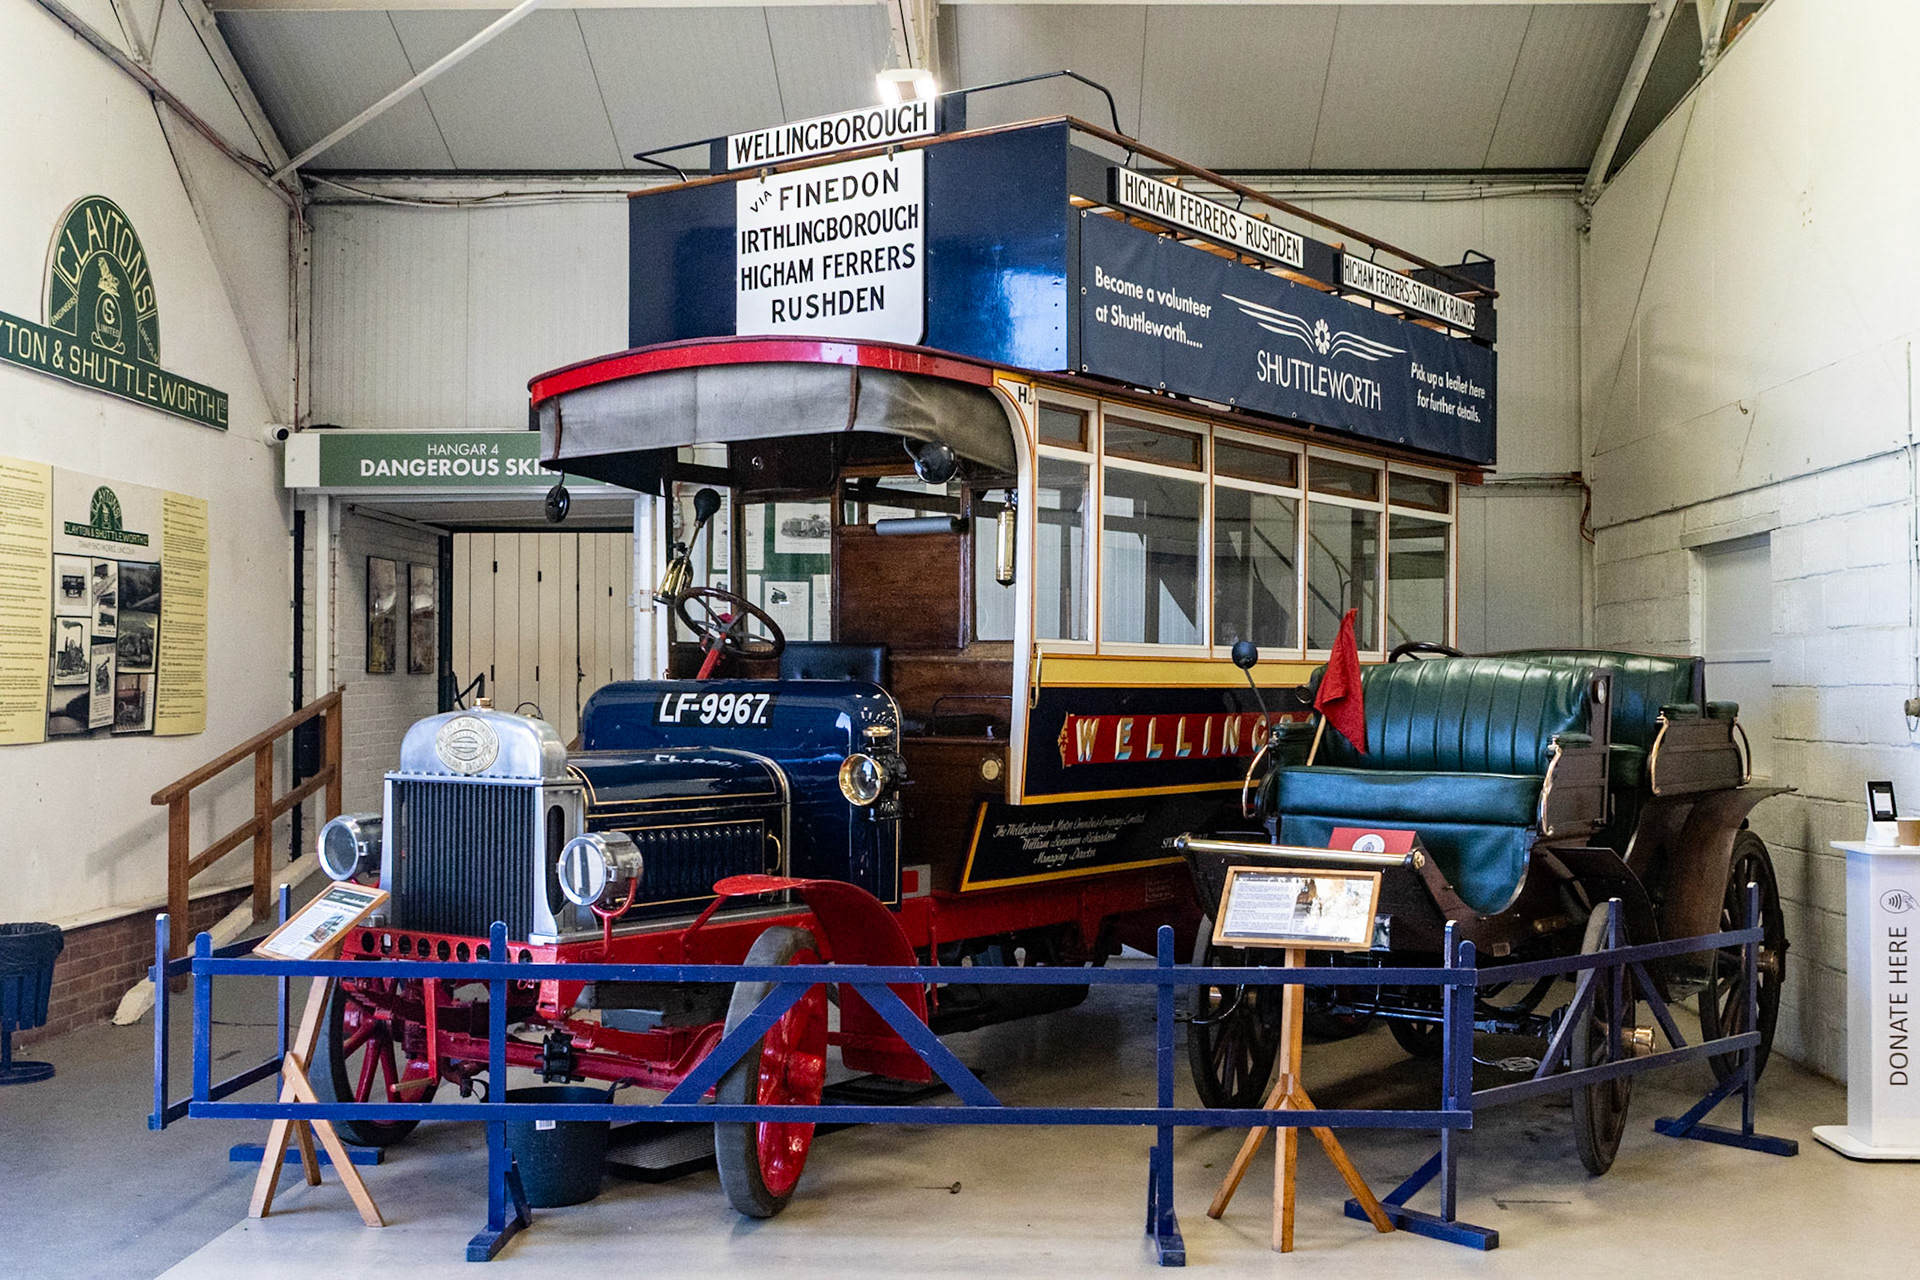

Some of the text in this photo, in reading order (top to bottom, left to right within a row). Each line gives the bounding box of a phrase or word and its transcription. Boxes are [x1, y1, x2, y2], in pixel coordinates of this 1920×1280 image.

[735, 102, 928, 164] WELLINGBOROUGH
[750, 167, 899, 213] VIA FINEDON
[741, 204, 919, 254] IRTHLINGBOROUGH
[1125, 173, 1300, 263] HIGHAM FERRERS RUSHDEN
[57, 205, 154, 313] CLAYTONS
[741, 243, 916, 291] HIGHAM FERRERS
[772, 285, 885, 323] RUSHDEN
[1095, 265, 1212, 319] Become a volunteer
[1095, 304, 1109, 323] at
[1344, 257, 1374, 291] HIGHAM
[1376, 269, 1410, 304] FERRERS
[1450, 297, 1476, 327] RAUNDS
[99, 323, 121, 338] LIMITED
[0, 319, 47, 364] TON
[52, 339, 64, 369] &
[69, 345, 215, 420] SHUTTLEWORTH
[1256, 349, 1381, 411] SHUTTLEWORTH
[1411, 361, 1486, 399] Pick up a leaflet here
[1417, 388, 1429, 408] for
[1429, 392, 1456, 415] further
[360, 458, 500, 477] DANGEROUS
[427, 443, 499, 456] HANGAR 4
[1888, 926, 1909, 1086] DONATE HERE
